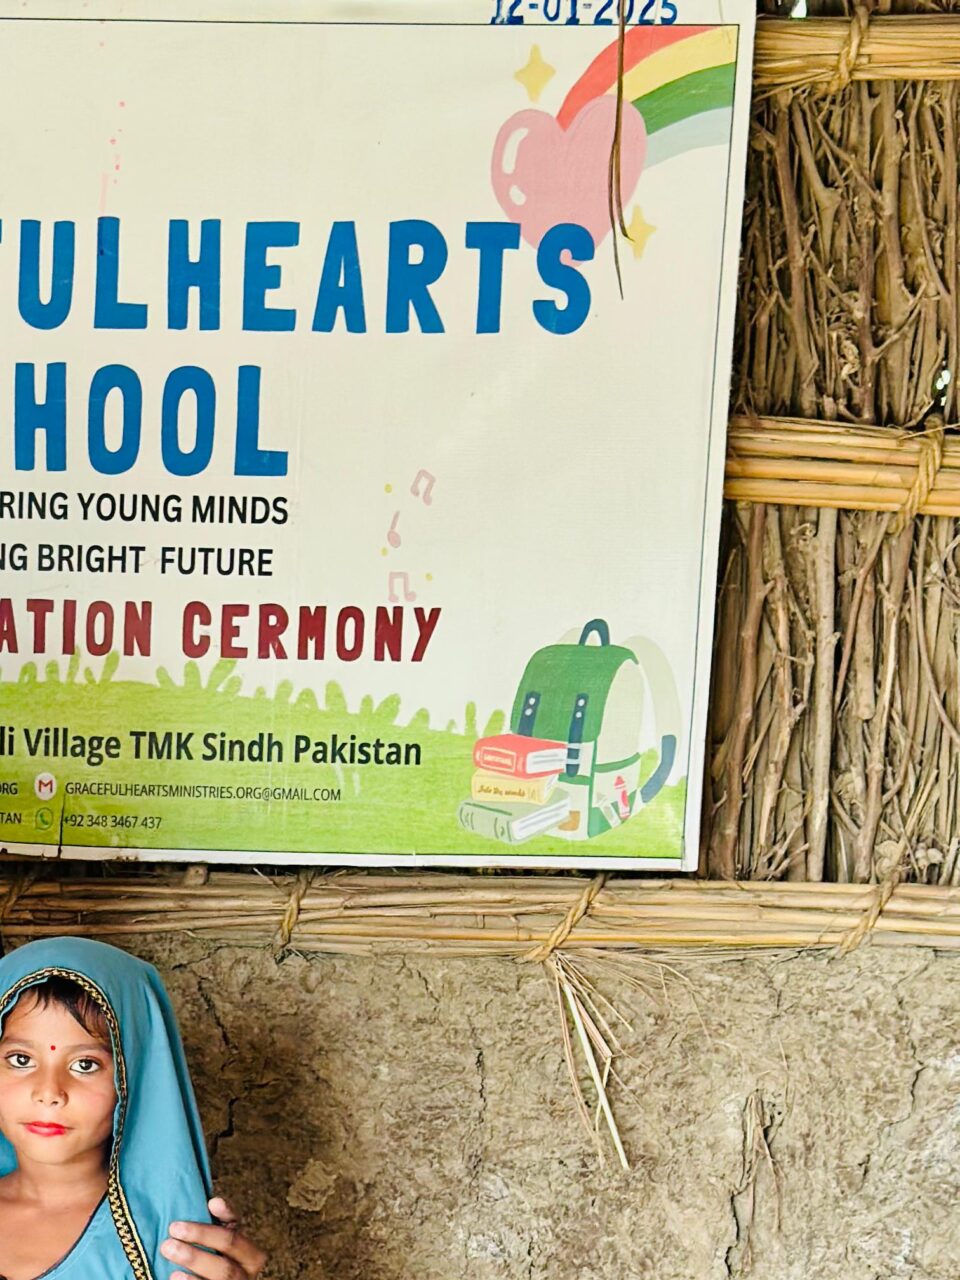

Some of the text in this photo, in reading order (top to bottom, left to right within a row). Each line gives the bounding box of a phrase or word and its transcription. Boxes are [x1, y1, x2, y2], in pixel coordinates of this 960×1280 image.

[76, 492, 182, 523] YOUNG
[191, 495, 289, 525] MINDS
[38, 544, 145, 575] BRIGHT
[160, 547, 273, 577] FUTURE
[183, 600, 442, 663] CERMONY
[24, 727, 121, 767] Village
[130, 730, 194, 760] TMK
[202, 731, 283, 763] Sindh
[294, 734, 422, 766] Pakistan
[65, 781, 342, 801] GRACEFULHEARTSMINISTRIES.ORG@GMAIL.COM
[86, 814, 108, 828] 348
[110, 815, 138, 829] 3467
[140, 816, 162, 829] 437
